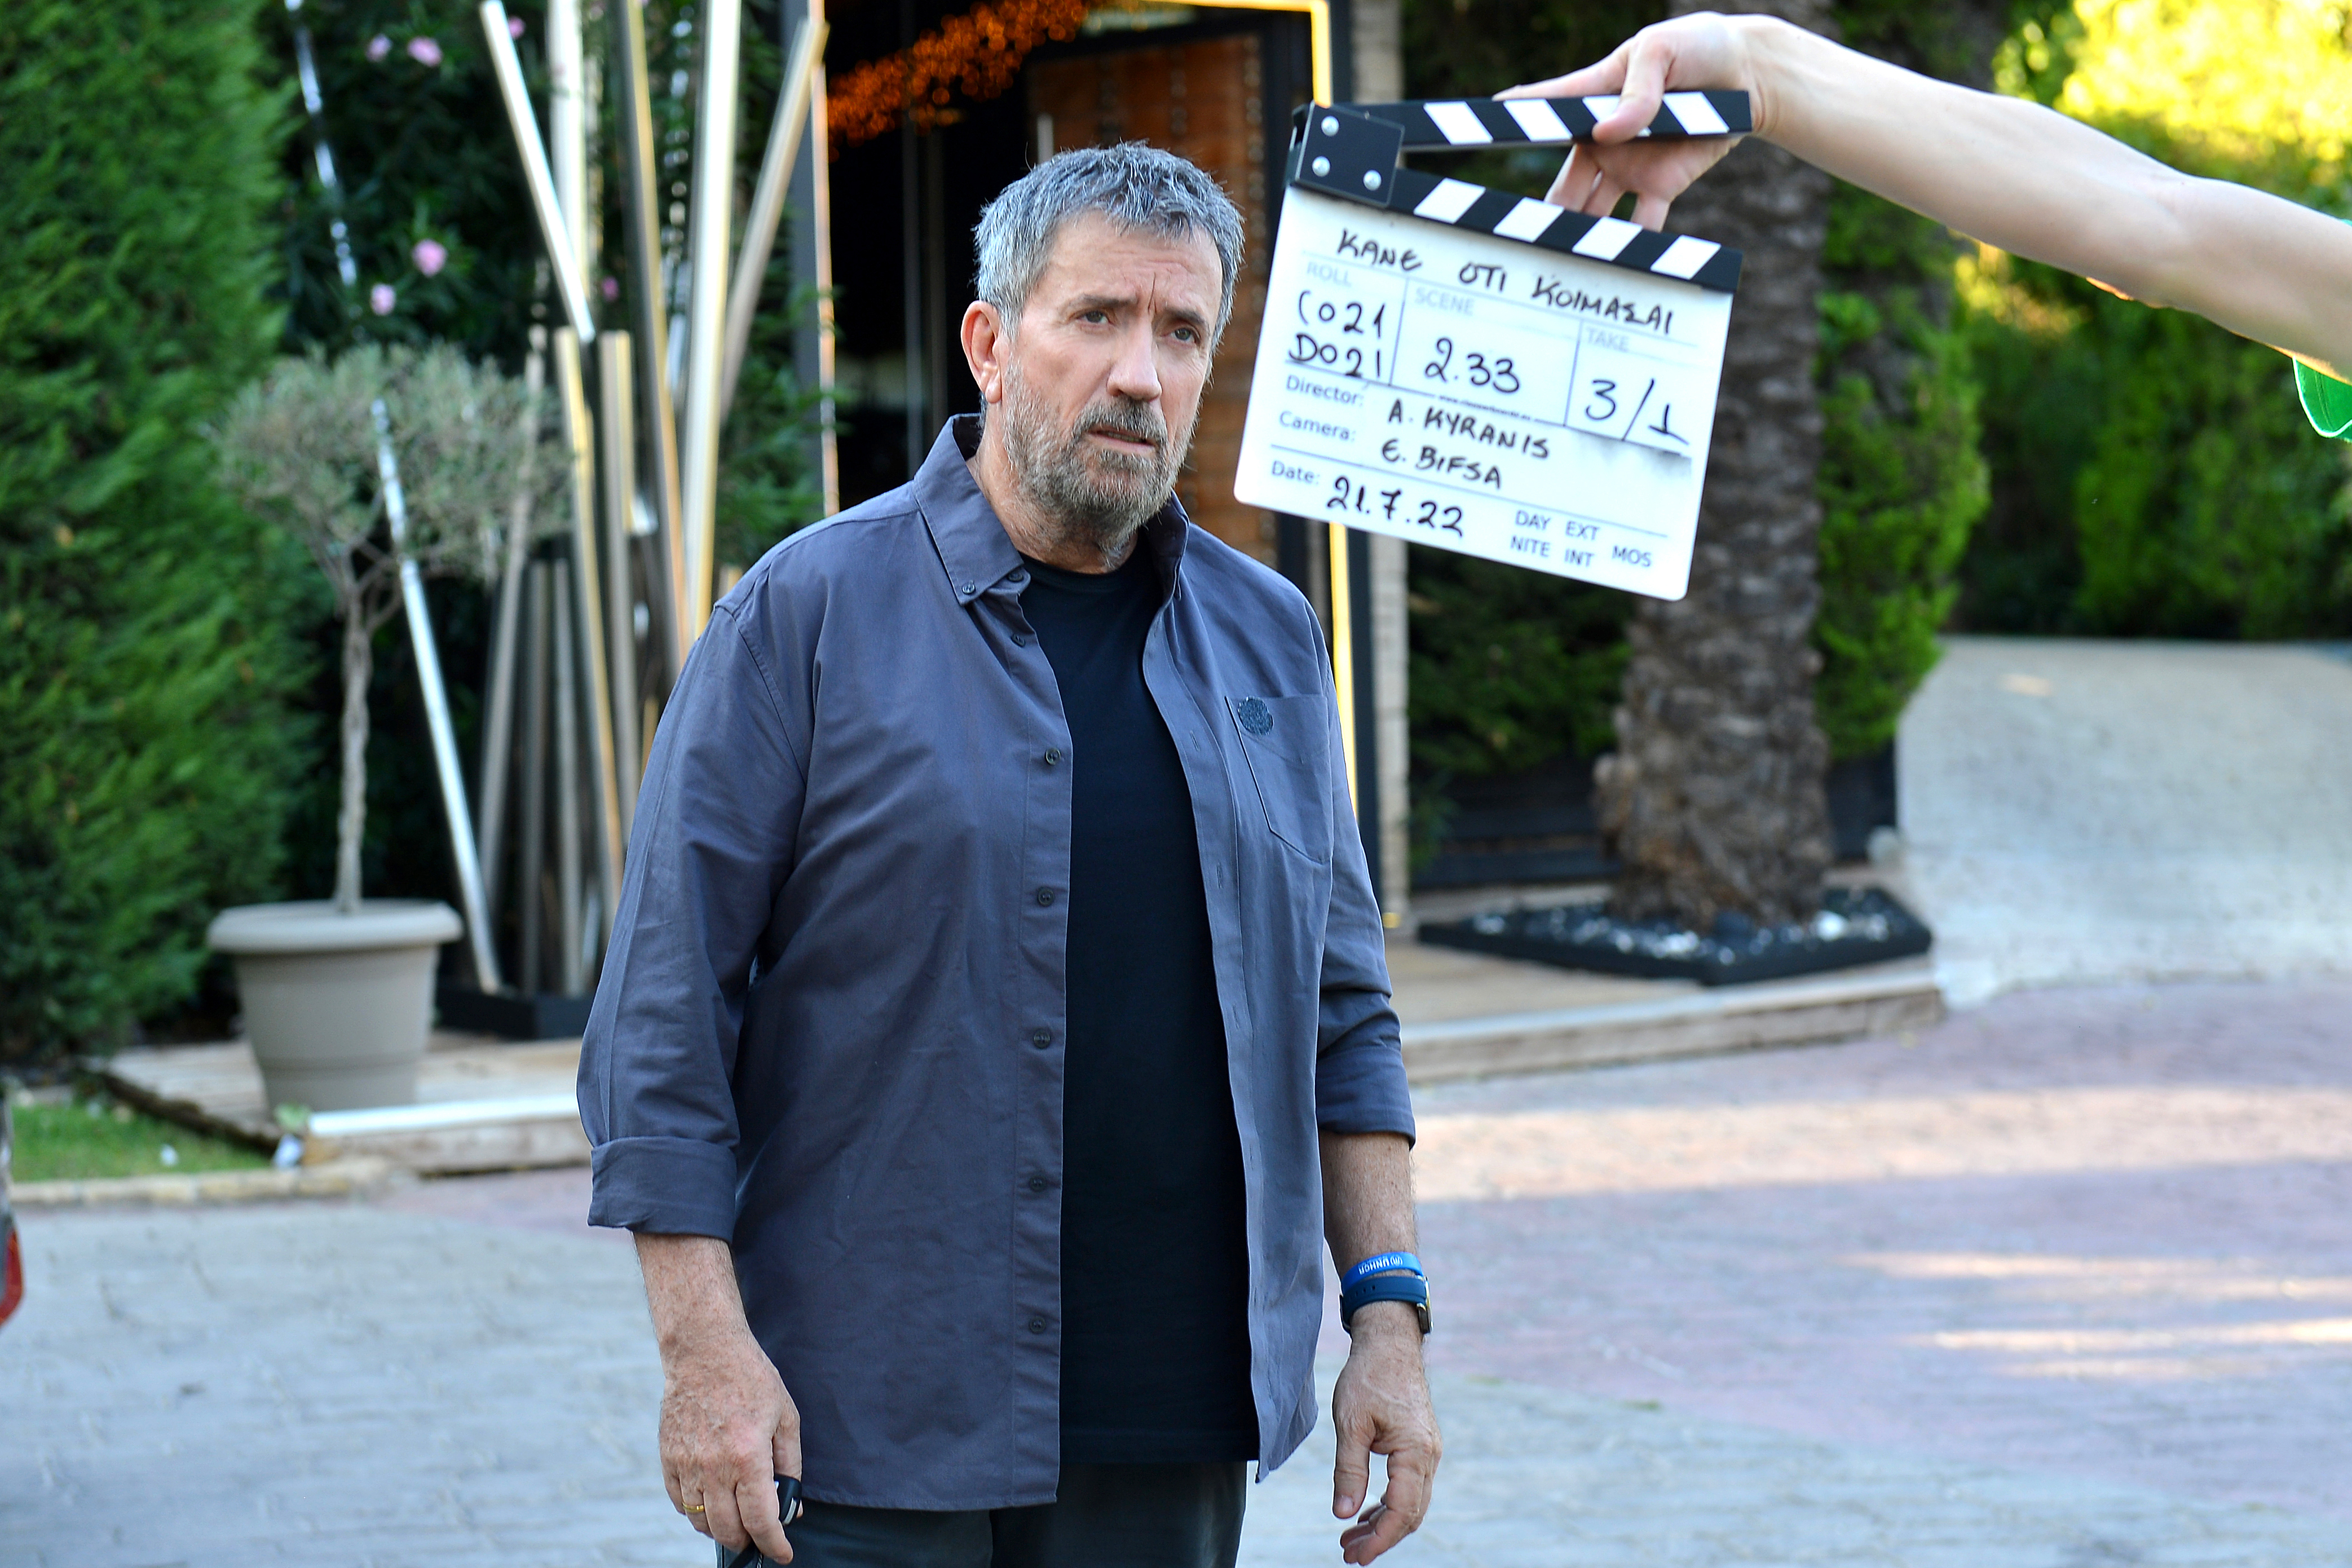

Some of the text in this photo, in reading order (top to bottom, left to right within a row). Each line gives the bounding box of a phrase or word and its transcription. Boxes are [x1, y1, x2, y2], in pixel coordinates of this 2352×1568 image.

[1307, 262, 1351, 286] ROLL
[1415, 287, 1475, 316] SCENE
[1586, 327, 1630, 352] TAKE
[1424, 337, 1520, 393] 2.33
[1286, 374, 1364, 406] Director:
[1279, 410, 1356, 441] Camera:
[1424, 407, 1550, 459] KYRANIS
[1271, 460, 1320, 485] Date:
[1415, 445, 1502, 489] BIFSA
[1326, 475, 1463, 537] 21.7.22
[1515, 509, 1600, 541] DAY EXT
[1510, 536, 1652, 567] NITE INT MOS
